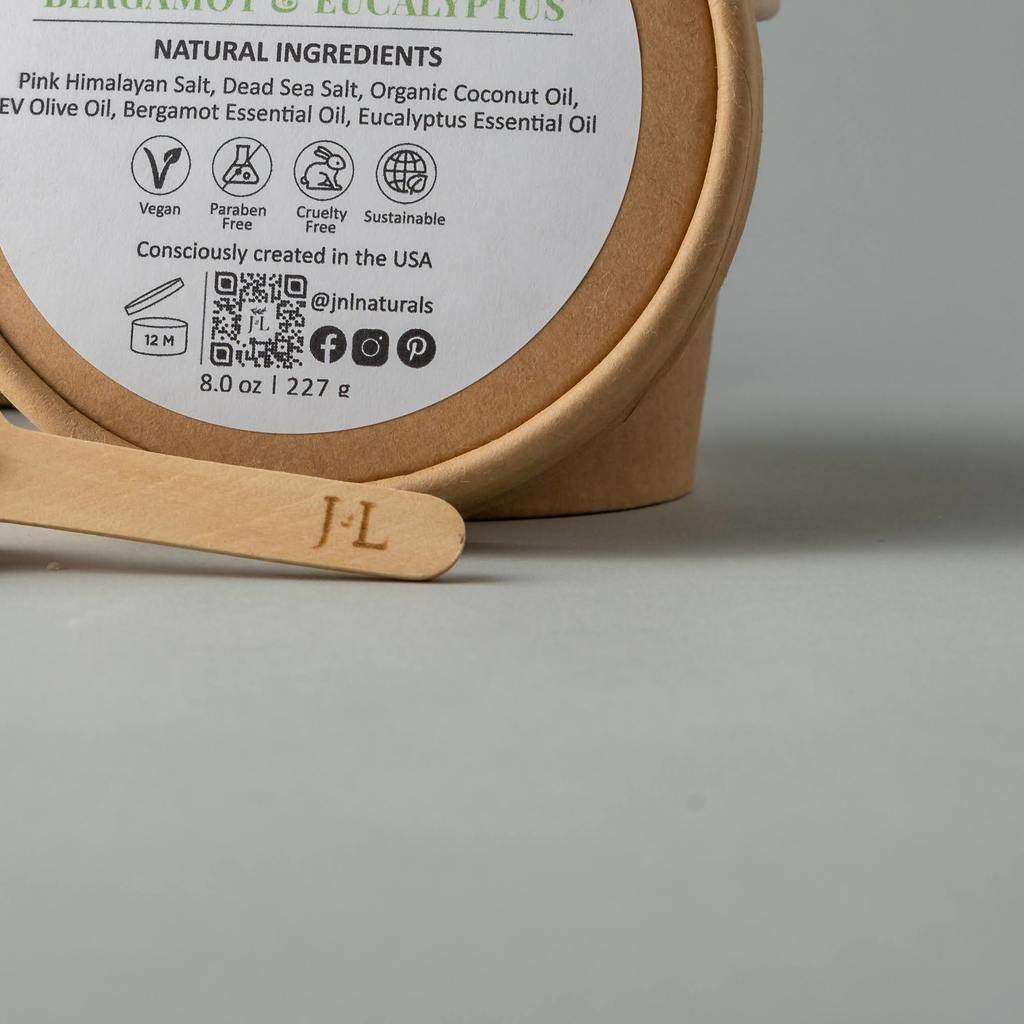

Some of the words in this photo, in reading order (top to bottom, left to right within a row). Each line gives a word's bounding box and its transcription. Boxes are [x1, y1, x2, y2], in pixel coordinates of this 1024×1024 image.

[154, 39, 268, 62] NATURAL
[276, 43, 442, 67] INGREDIENTS
[19, 72, 59, 90] Pink
[66, 74, 167, 96] Himalayan
[174, 76, 215, 97] Salt,
[224, 77, 273, 95] Dead
[280, 79, 314, 97] Sea
[321, 80, 363, 102] Salt,
[370, 82, 447, 104] Organic
[454, 85, 539, 104] Coconut
[545, 88, 578, 109] Oil,
[0, 98, 24, 114] EV
[30, 98, 78, 116] Olive
[85, 99, 115, 120] Oil,
[124, 101, 219, 122] Bergamot
[226, 104, 312, 122] Essential
[319, 106, 350, 127] Oil,
[359, 108, 466, 131] Eucalyptus
[474, 112, 562, 132] Essential
[569, 115, 596, 133] Oil
[140, 202, 180, 217] Vegan
[211, 203, 266, 216] Paraben
[297, 206, 347, 223] Cruelty
[364, 210, 445, 225] Sustainable
[223, 218, 252, 230] Free
[306, 220, 336, 233] Free
[137, 241, 248, 265] Consciously
[254, 247, 325, 264] created
[333, 248, 348, 265] in
[355, 248, 386, 266] the
[394, 251, 432, 268] USA
[311, 292, 433, 314] @jnlnaturals
[145, 334, 158, 346] 12
[163, 335, 174, 346] M
[200, 374, 232, 392] 8.0
[239, 380, 262, 394] oz
[287, 377, 329, 397] 227
[339, 384, 350, 398] g
